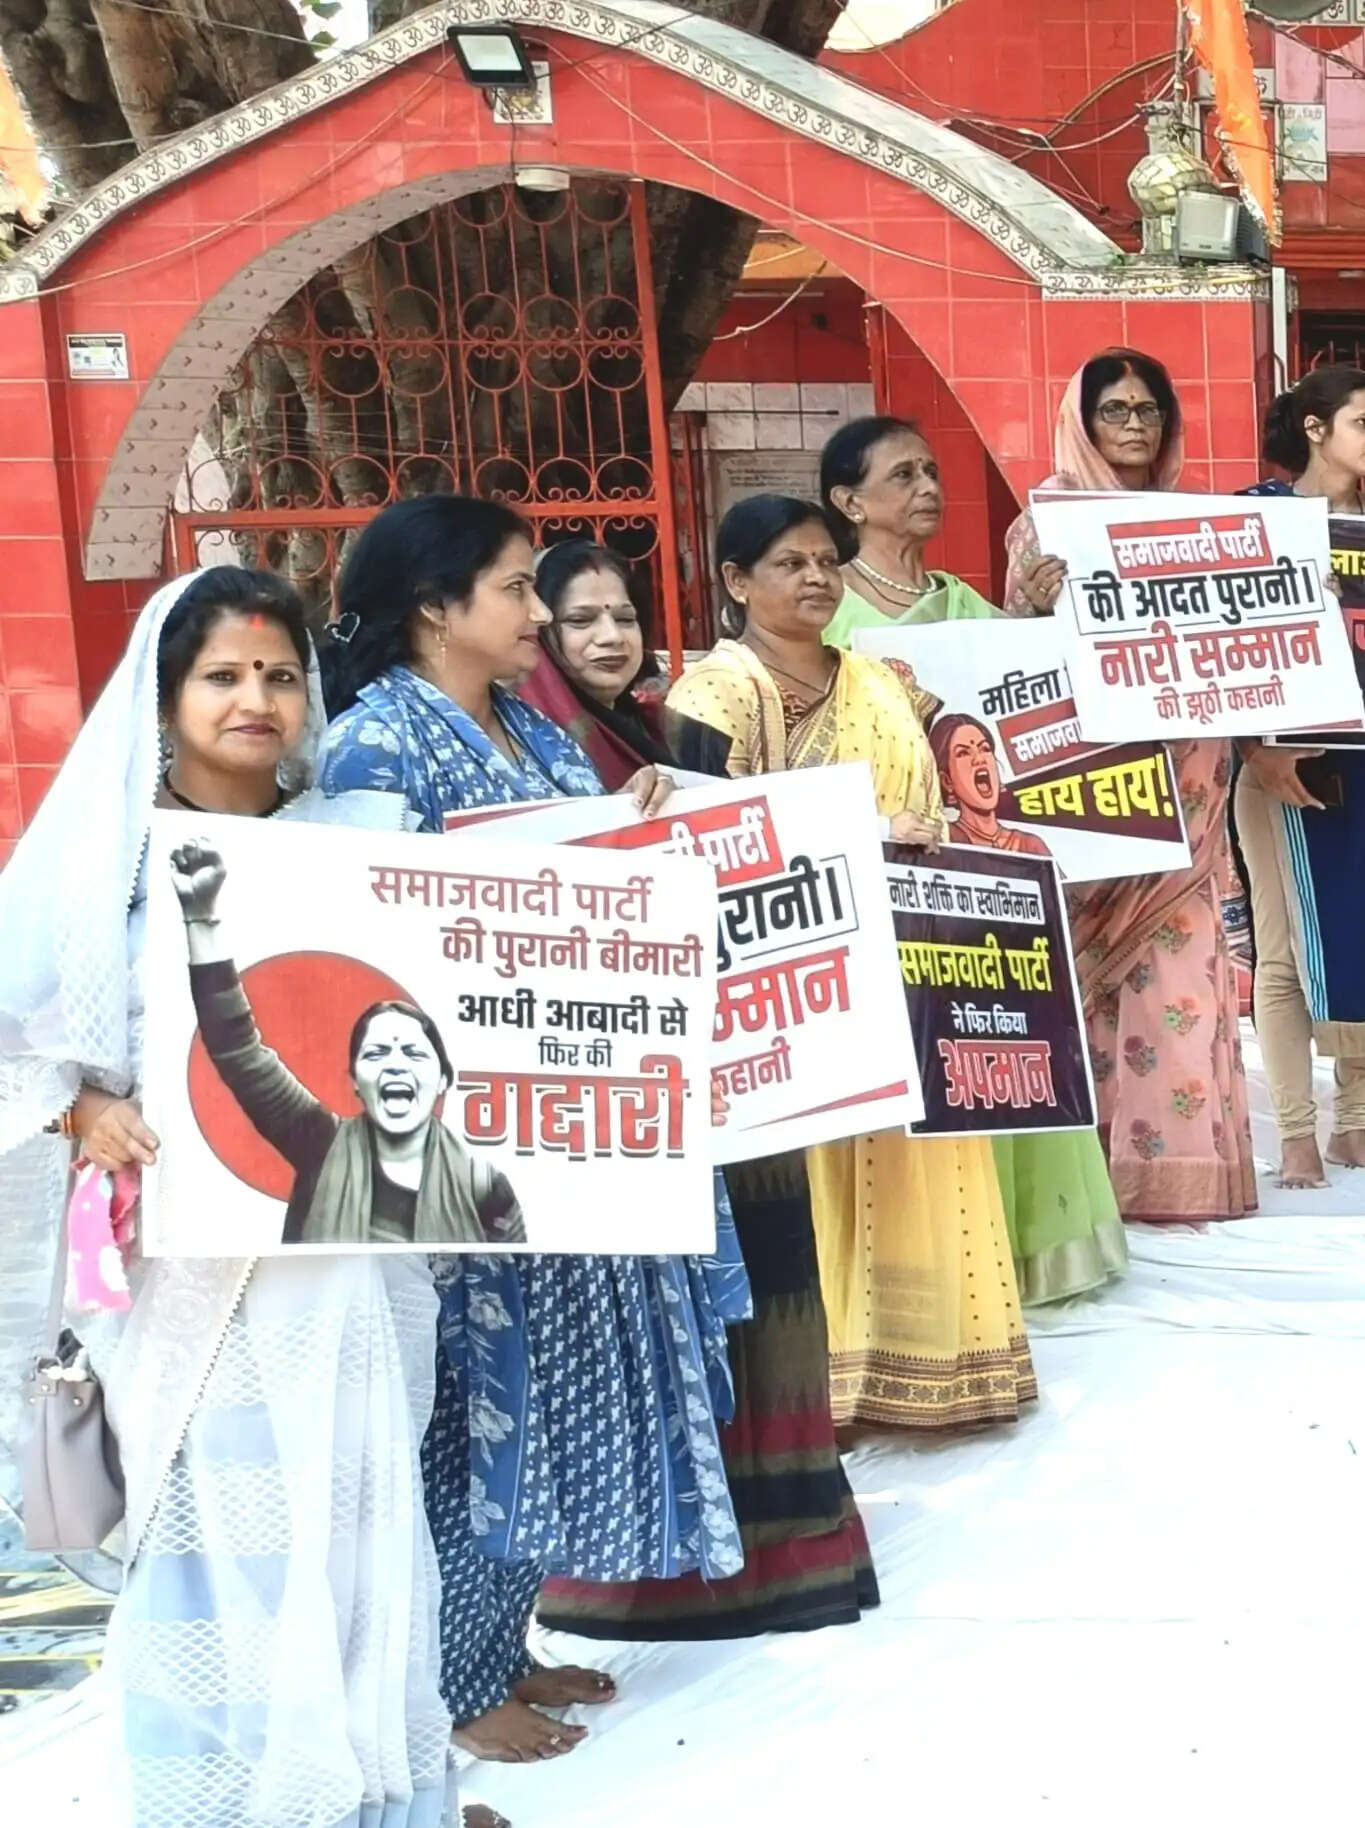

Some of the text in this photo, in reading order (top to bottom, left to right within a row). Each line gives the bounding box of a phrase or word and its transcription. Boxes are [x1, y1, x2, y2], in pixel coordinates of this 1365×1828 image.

[1112, 517, 1265, 570] समाजवादी पार्टी
[1082, 570, 1125, 623] की
[1130, 574, 1210, 618] आदत
[1093, 620, 1182, 688] नारी
[1183, 621, 1322, 680] सम्मान
[978, 669, 1063, 717] महिला
[1153, 686, 1182, 721] की
[1223, 674, 1286, 711] कहानी
[1010, 715, 1083, 762] समाजवा
[1013, 752, 1175, 818] हाय हाय!
[368, 865, 654, 924] समाजवादी पार्टी
[886, 870, 1042, 921] नारी शक्ति का स्वाभिमान
[439, 916, 704, 979] की पुरानी बीमारी
[897, 932, 1053, 992] समाजवादी पार्टी
[457, 988, 689, 1036] आधी आबादी से
[712, 945, 851, 1042] म्मान
[950, 1000, 1028, 1035] ने फिर किया
[538, 1036, 613, 1068] फिर की
[938, 1037, 1058, 1111] अपमान
[456, 1053, 693, 1162] गद्दारी
